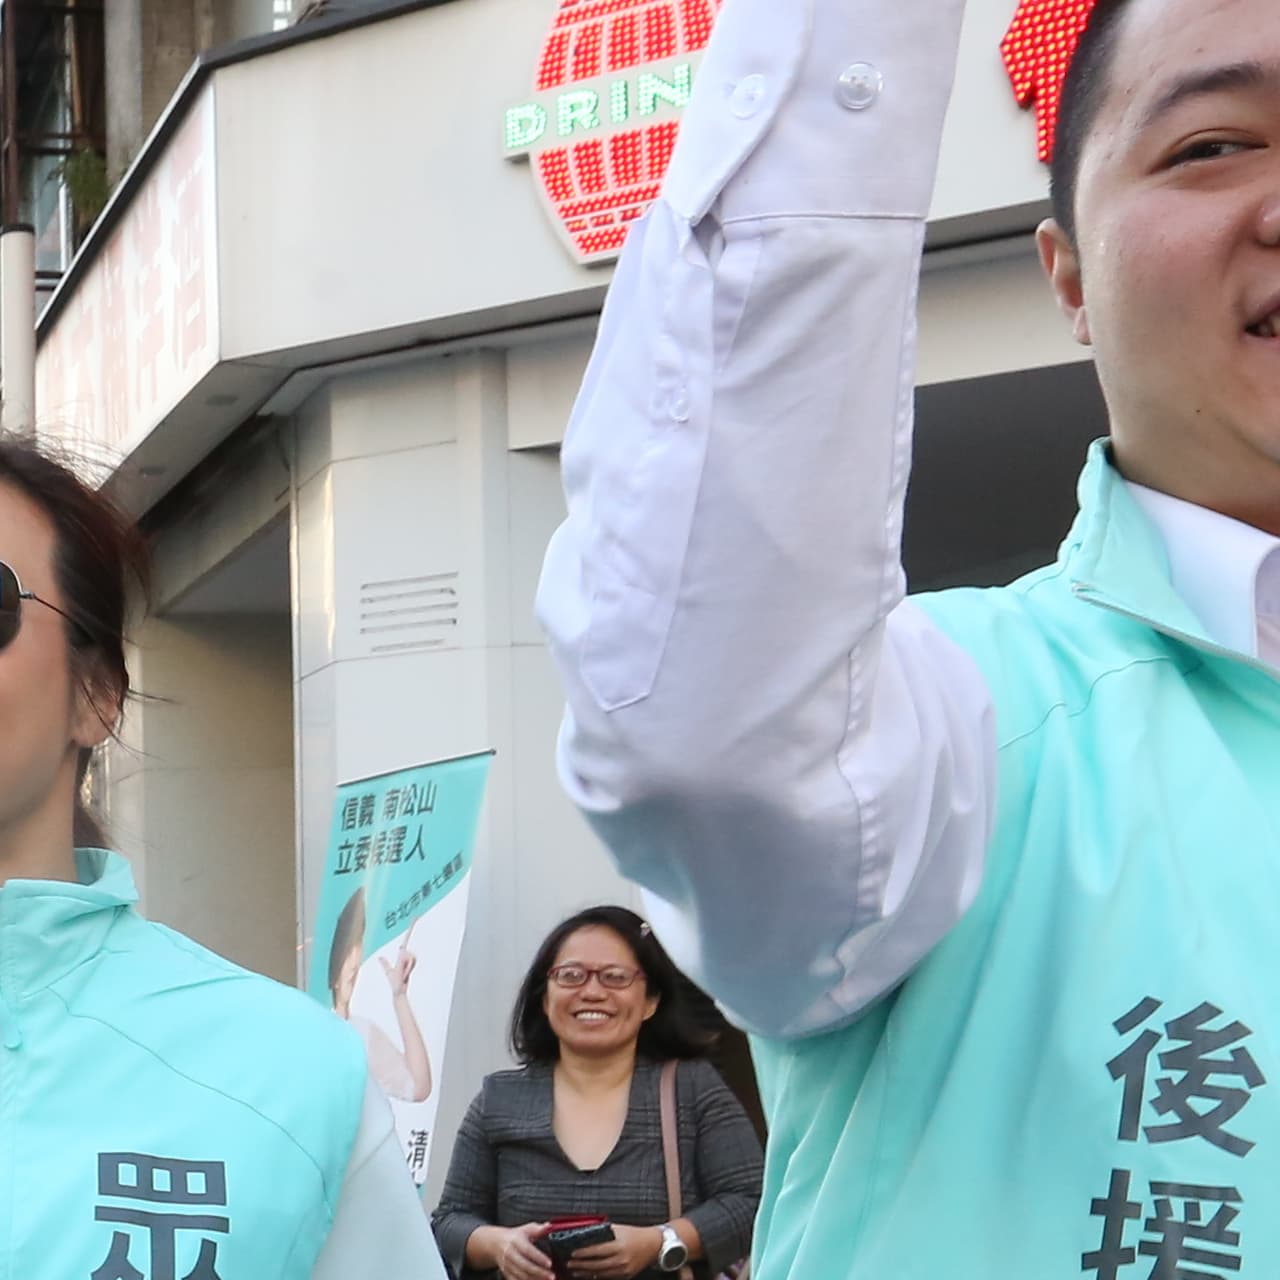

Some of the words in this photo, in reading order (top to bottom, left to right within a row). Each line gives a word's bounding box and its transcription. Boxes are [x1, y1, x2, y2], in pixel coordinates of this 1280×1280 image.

[505, 62, 691, 148] DRIN
[341, 794, 376, 831] 信義
[383, 780, 438, 821] 南松山
[334, 824, 426, 876] 立委候選人
